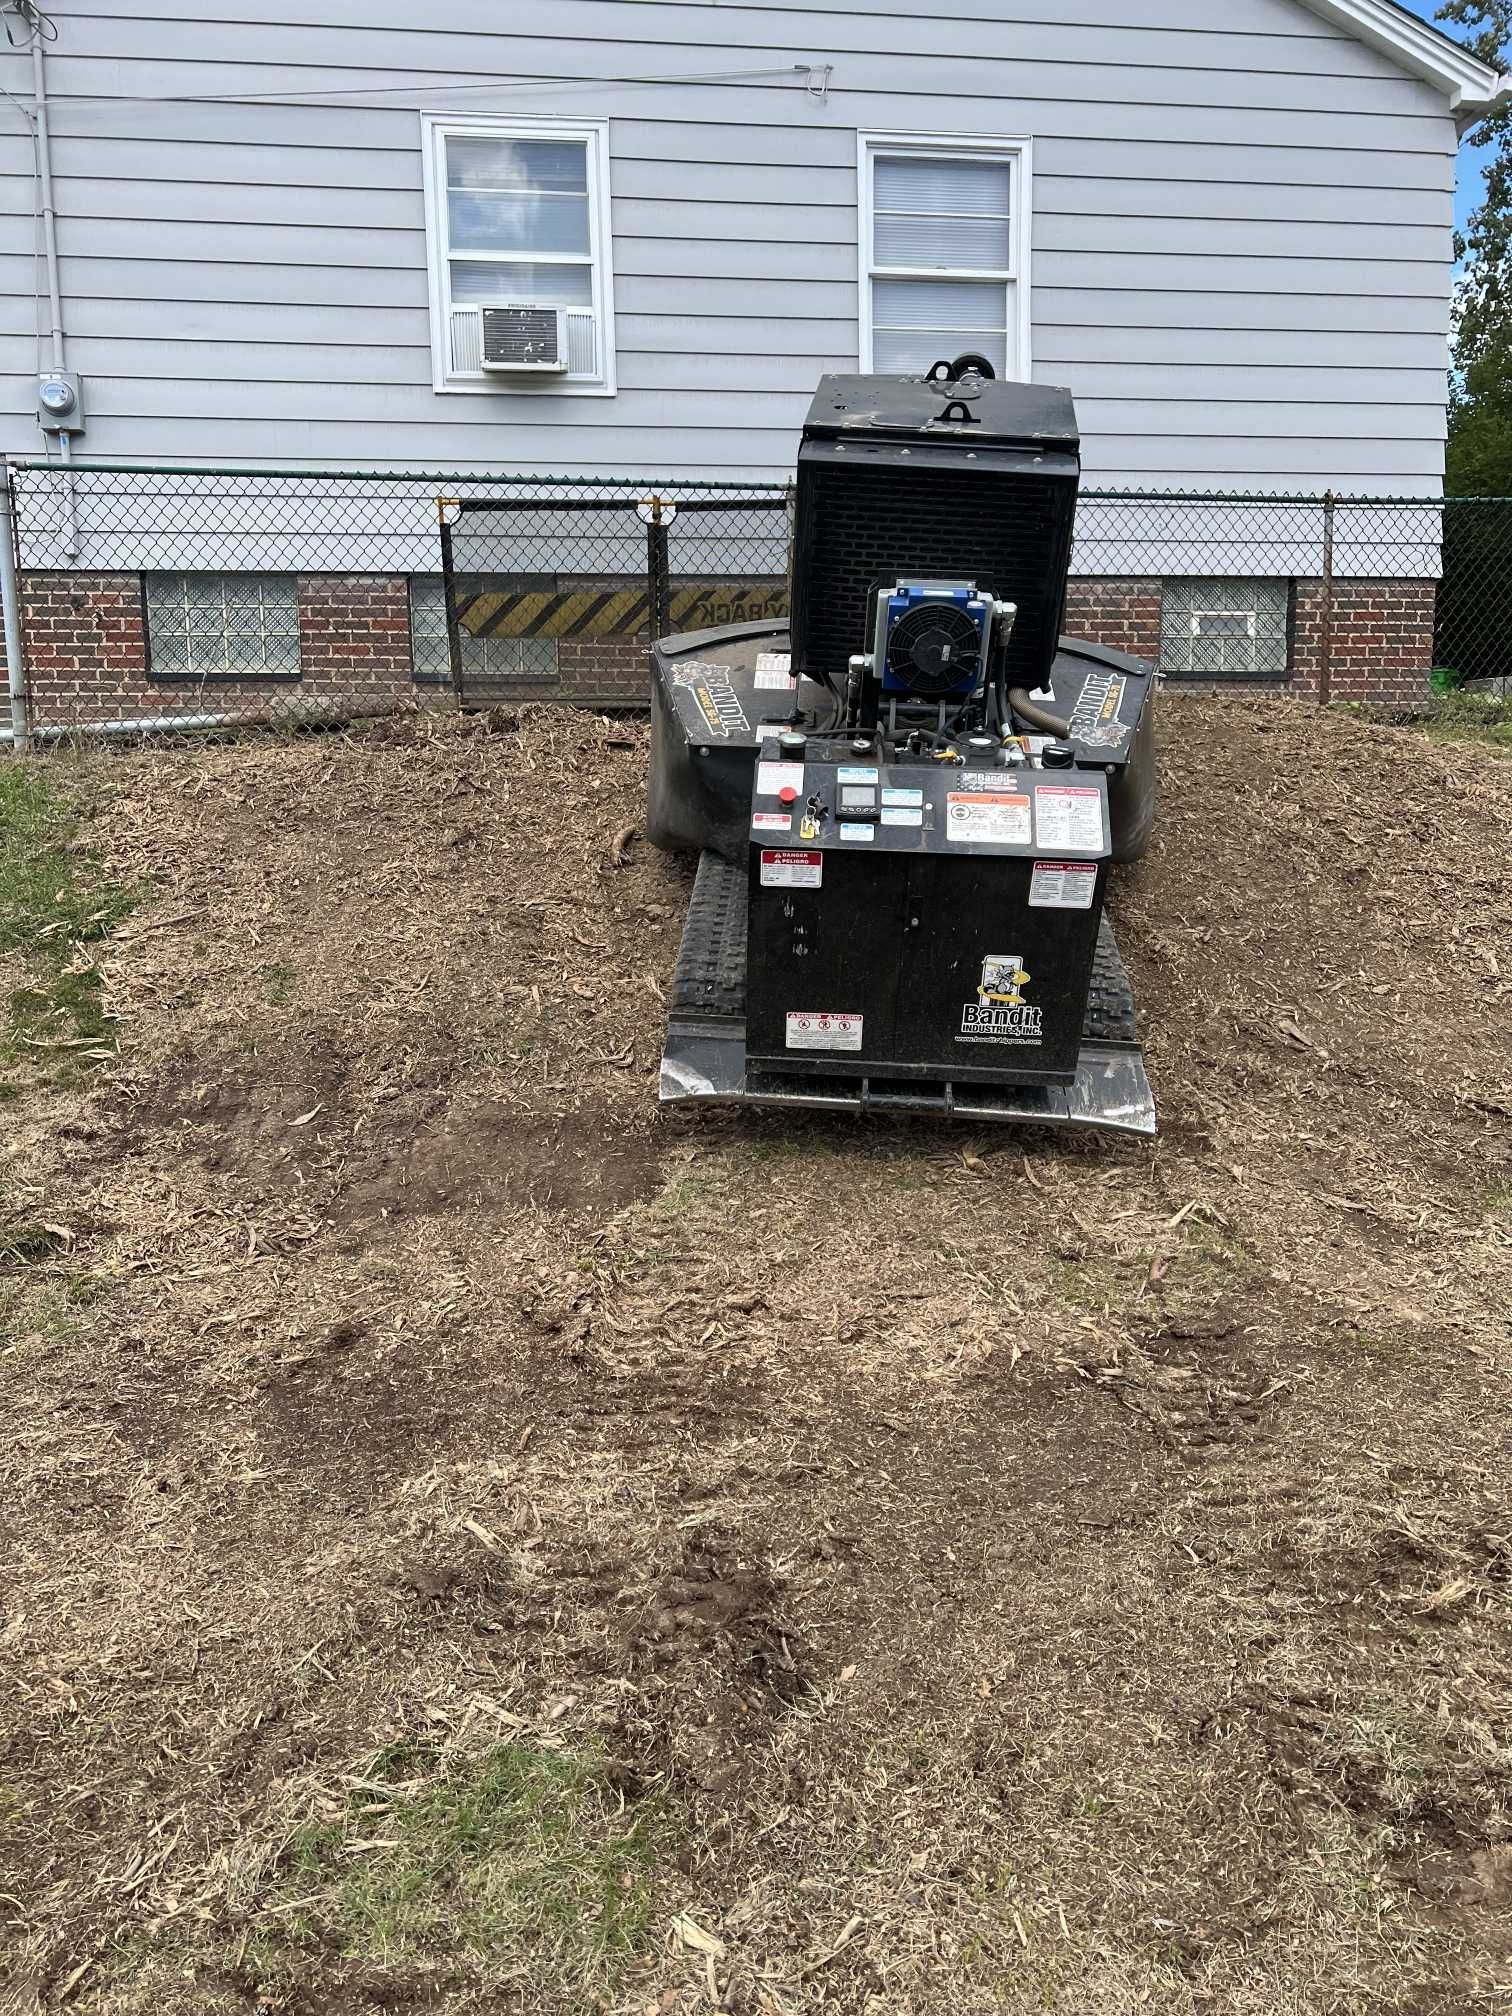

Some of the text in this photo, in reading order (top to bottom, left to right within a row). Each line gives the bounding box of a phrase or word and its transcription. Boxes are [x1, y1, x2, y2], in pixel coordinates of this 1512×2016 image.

[1070, 674, 1112, 728] BANDIT
[962, 1003, 1042, 1026] Bandit
[961, 1023, 1042, 1036] INDUSTRIES, INC.
